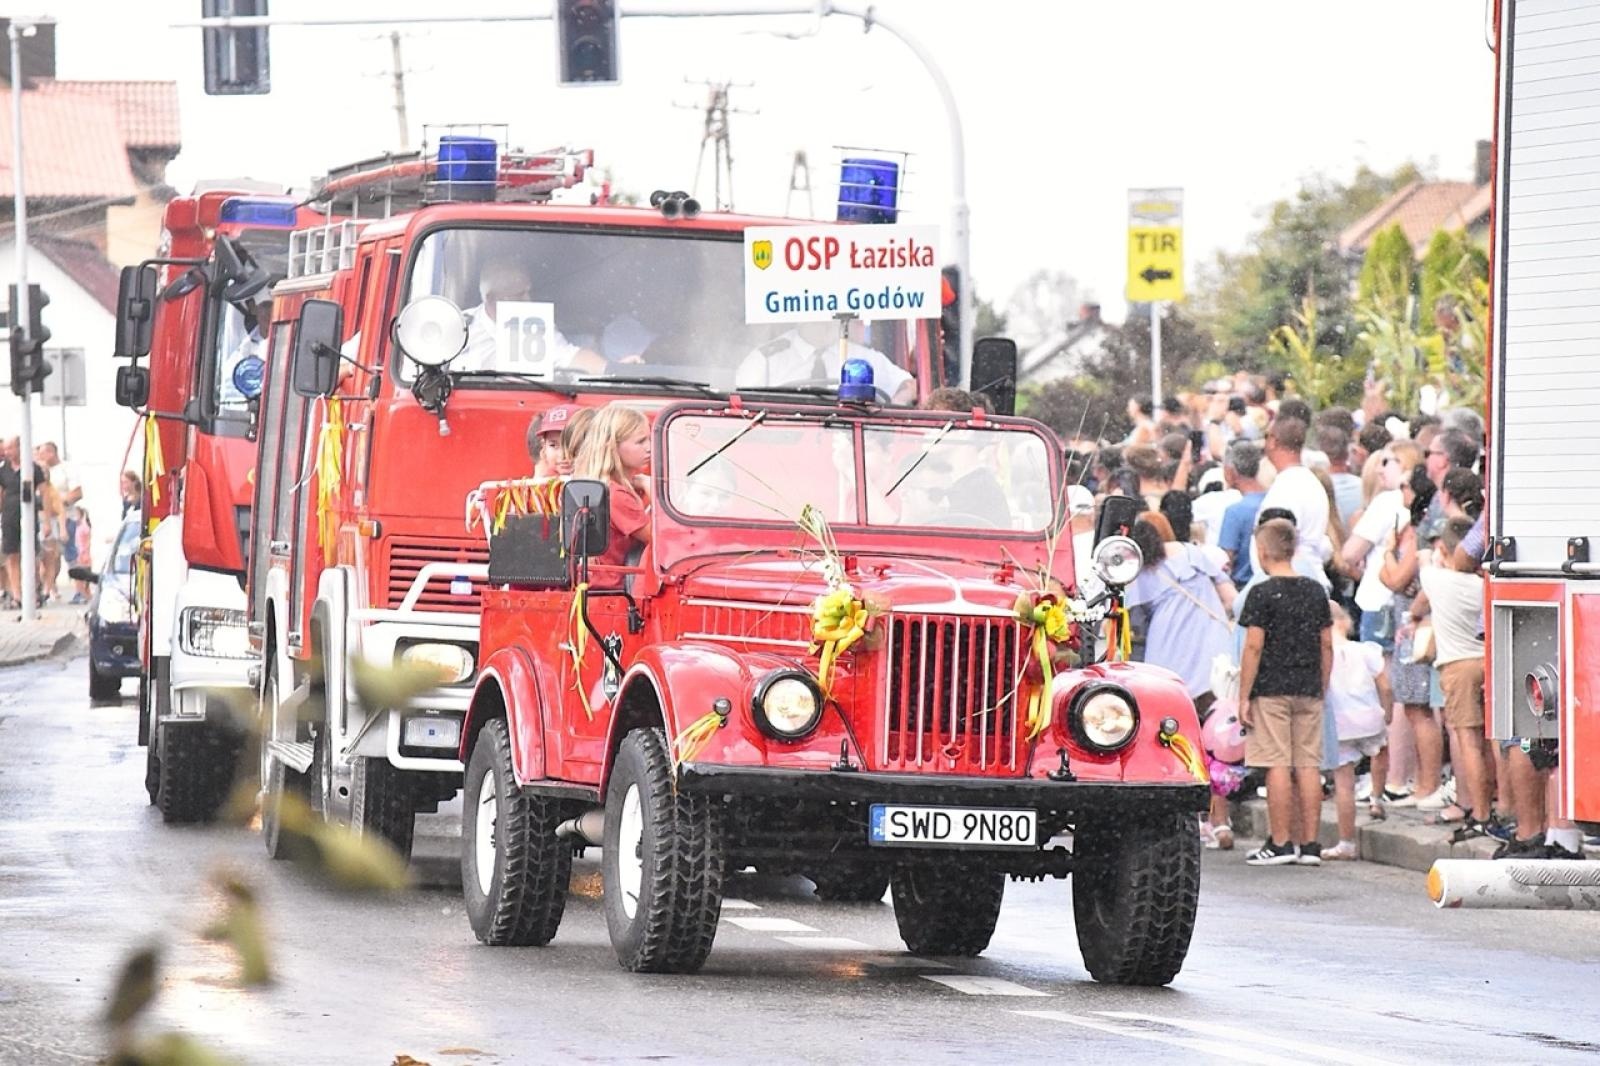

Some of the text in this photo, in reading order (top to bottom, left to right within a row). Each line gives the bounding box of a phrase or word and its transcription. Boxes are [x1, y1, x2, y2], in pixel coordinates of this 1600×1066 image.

[784, 236, 934, 271] OSP Łaziska
[1135, 232, 1177, 254] TIR
[765, 286, 924, 313] Gmina Godów
[504, 316, 546, 363] 18
[890, 810, 1031, 842] SWD 9N80
